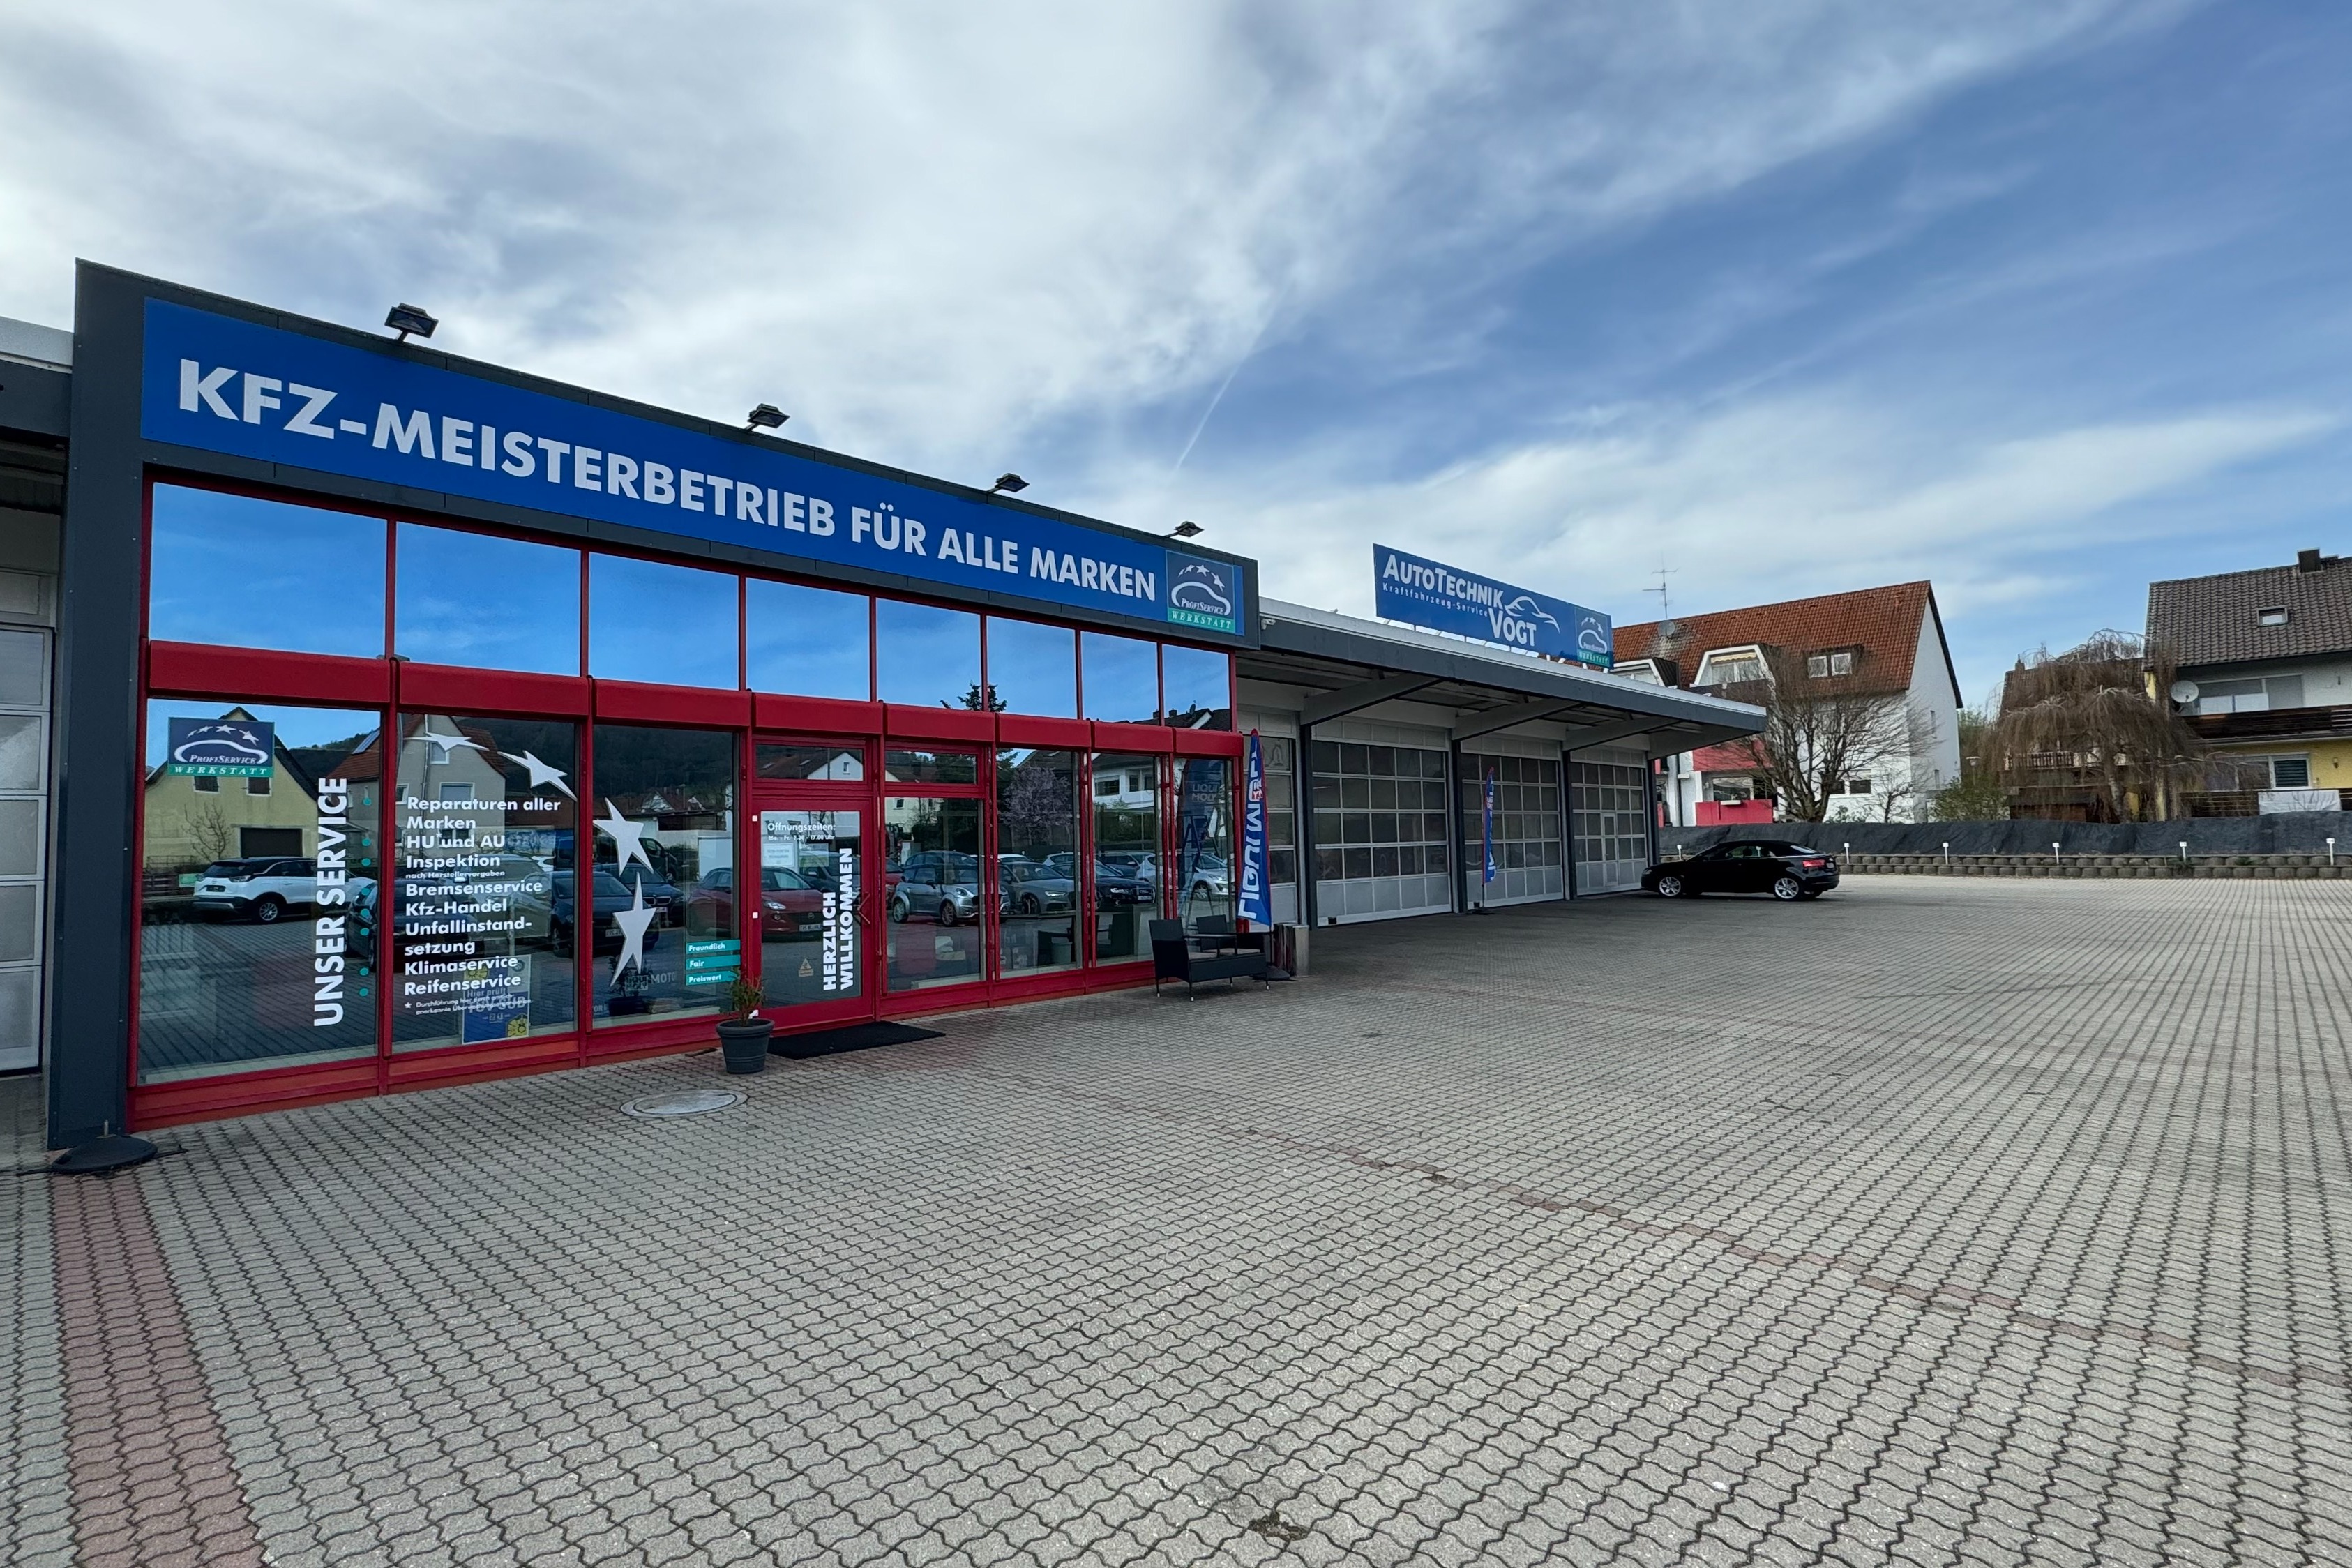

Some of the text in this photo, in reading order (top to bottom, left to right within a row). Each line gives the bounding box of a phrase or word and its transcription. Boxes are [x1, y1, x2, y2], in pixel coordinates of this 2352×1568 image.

[179, 359, 1156, 601] KFZ-MEISTERBETRIEB FÜR ALLE MARKEN
[1382, 582, 1488, 617] Kraftfahrzeug-Service
[1172, 610, 1231, 629] WERKSTATT
[174, 766, 268, 774] WERKSTATT
[407, 797, 561, 813] Reparaturen aller
[407, 815, 476, 829] Marken
[767, 821, 836, 832] Öffnungszeiten:
[442, 836, 475, 848] und
[480, 835, 505, 847] AU
[406, 853, 500, 870] Inspektion
[428, 870, 505, 879] Herstellervorgaben
[406, 880, 543, 896] Bremsenservice
[314, 778, 347, 1027] UNSER SERVICE
[406, 898, 507, 916] Kfz-Handel
[406, 916, 532, 936] Unfallinstand-
[839, 847, 854, 990] WILLKOMMEN
[405, 942, 476, 956] setzung
[688, 942, 725, 951] Freundlich
[822, 891, 836, 990] HERZLICH
[405, 956, 518, 975] Klimaservice
[405, 974, 522, 995] Reifenservice
[688, 974, 722, 983] Preiswert
